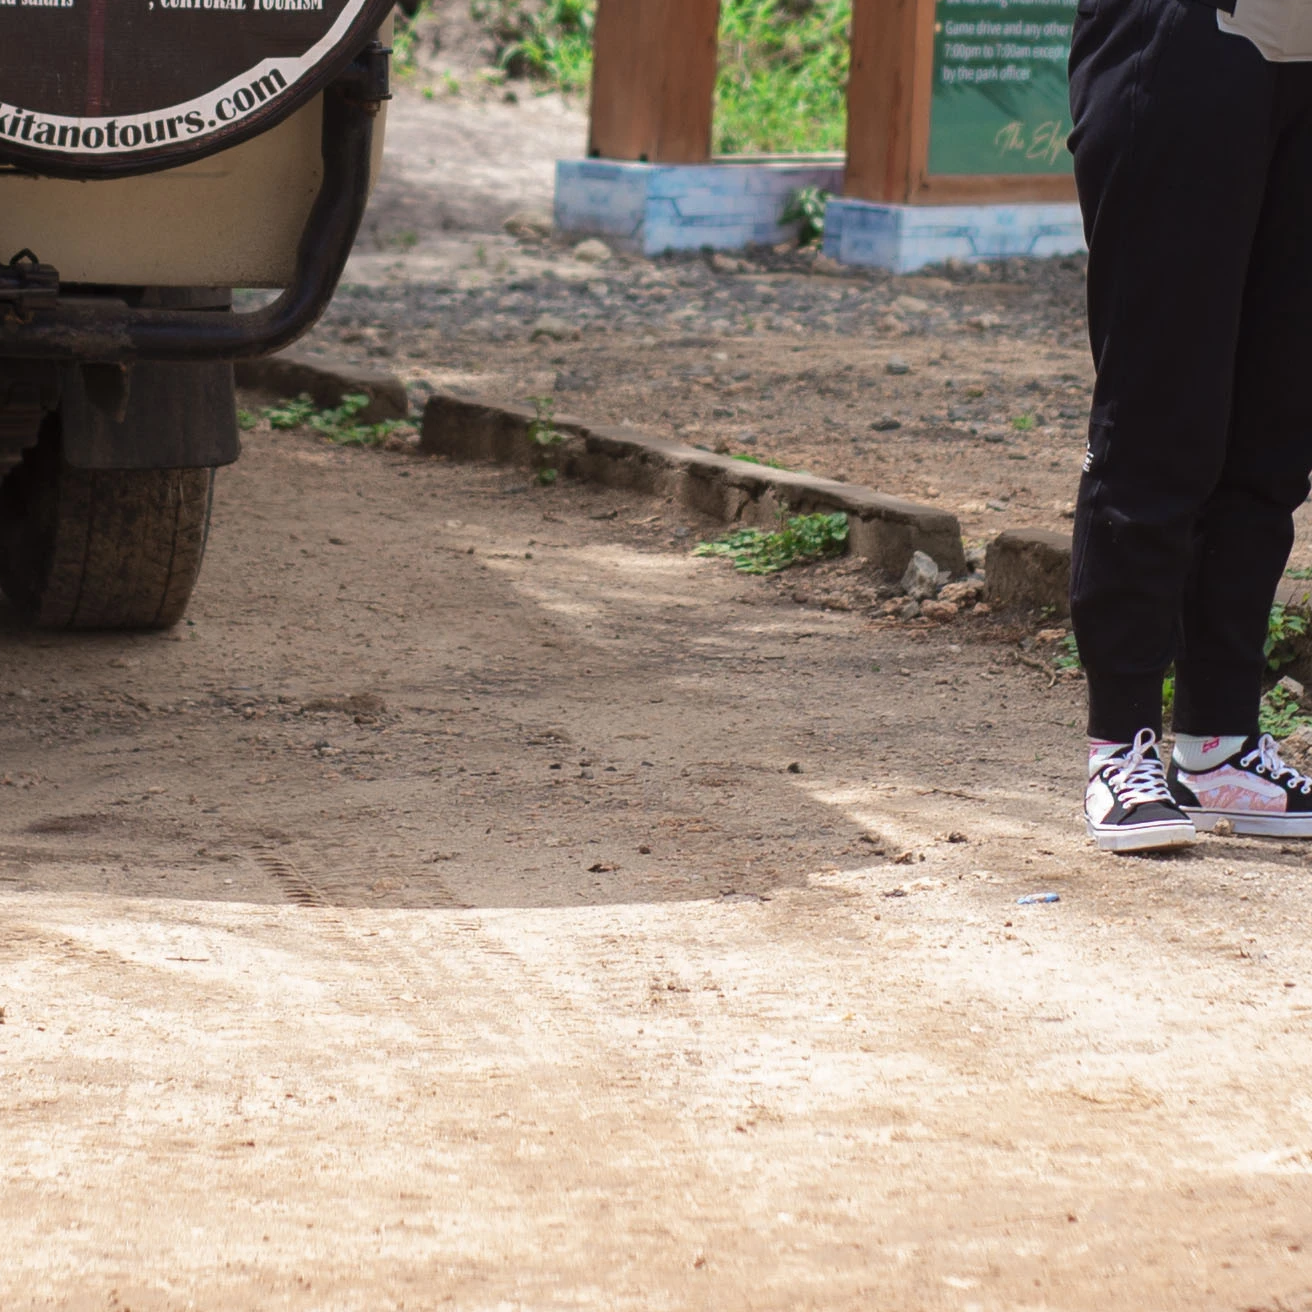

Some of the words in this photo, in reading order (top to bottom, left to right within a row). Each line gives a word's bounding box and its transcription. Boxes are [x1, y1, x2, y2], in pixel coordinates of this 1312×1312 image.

[945, 21, 975, 36] Game
[976, 20, 1001, 36] drive
[1003, 20, 1022, 36] and
[1024, 23, 1041, 39] any
[1043, 21, 1069, 36] other
[944, 43, 982, 60] 7:00pm
[983, 44, 994, 58] to
[996, 43, 1031, 58] 7:00am
[1033, 45, 1064, 63] except
[943, 65, 956, 84] by
[957, 66, 975, 81] the
[975, 66, 998, 83] park
[999, 64, 1031, 81] officer
